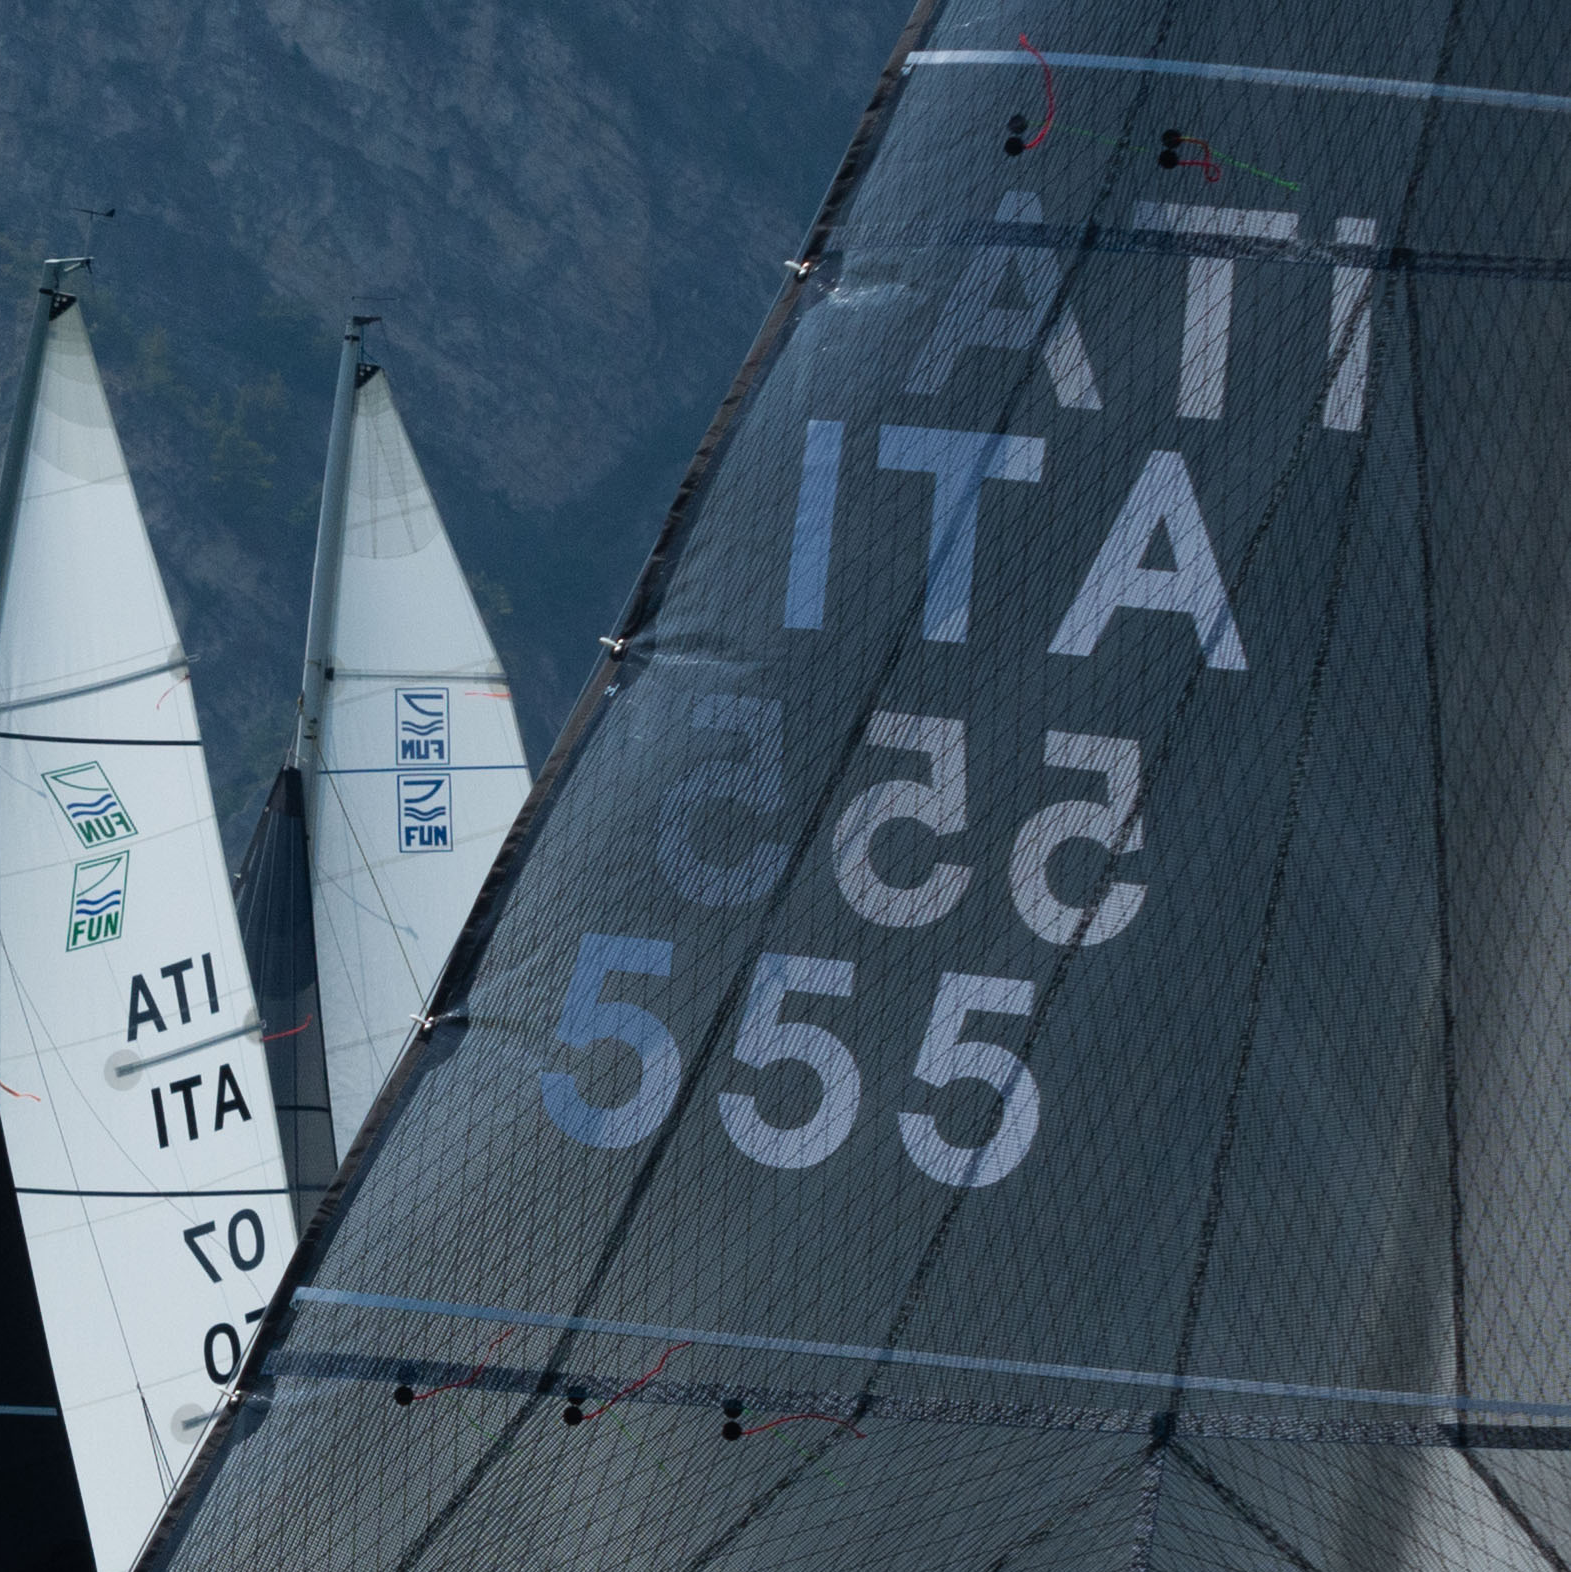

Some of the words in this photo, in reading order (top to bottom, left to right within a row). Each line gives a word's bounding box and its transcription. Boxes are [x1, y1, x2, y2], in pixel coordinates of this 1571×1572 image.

[782, 419, 1248, 671] ITA
[404, 825, 448, 847] FUN
[71, 910, 120, 947] FUN
[539, 931, 1041, 1188] 555
[150, 1063, 253, 1150] ITA
[203, 1305, 268, 1386] 0
